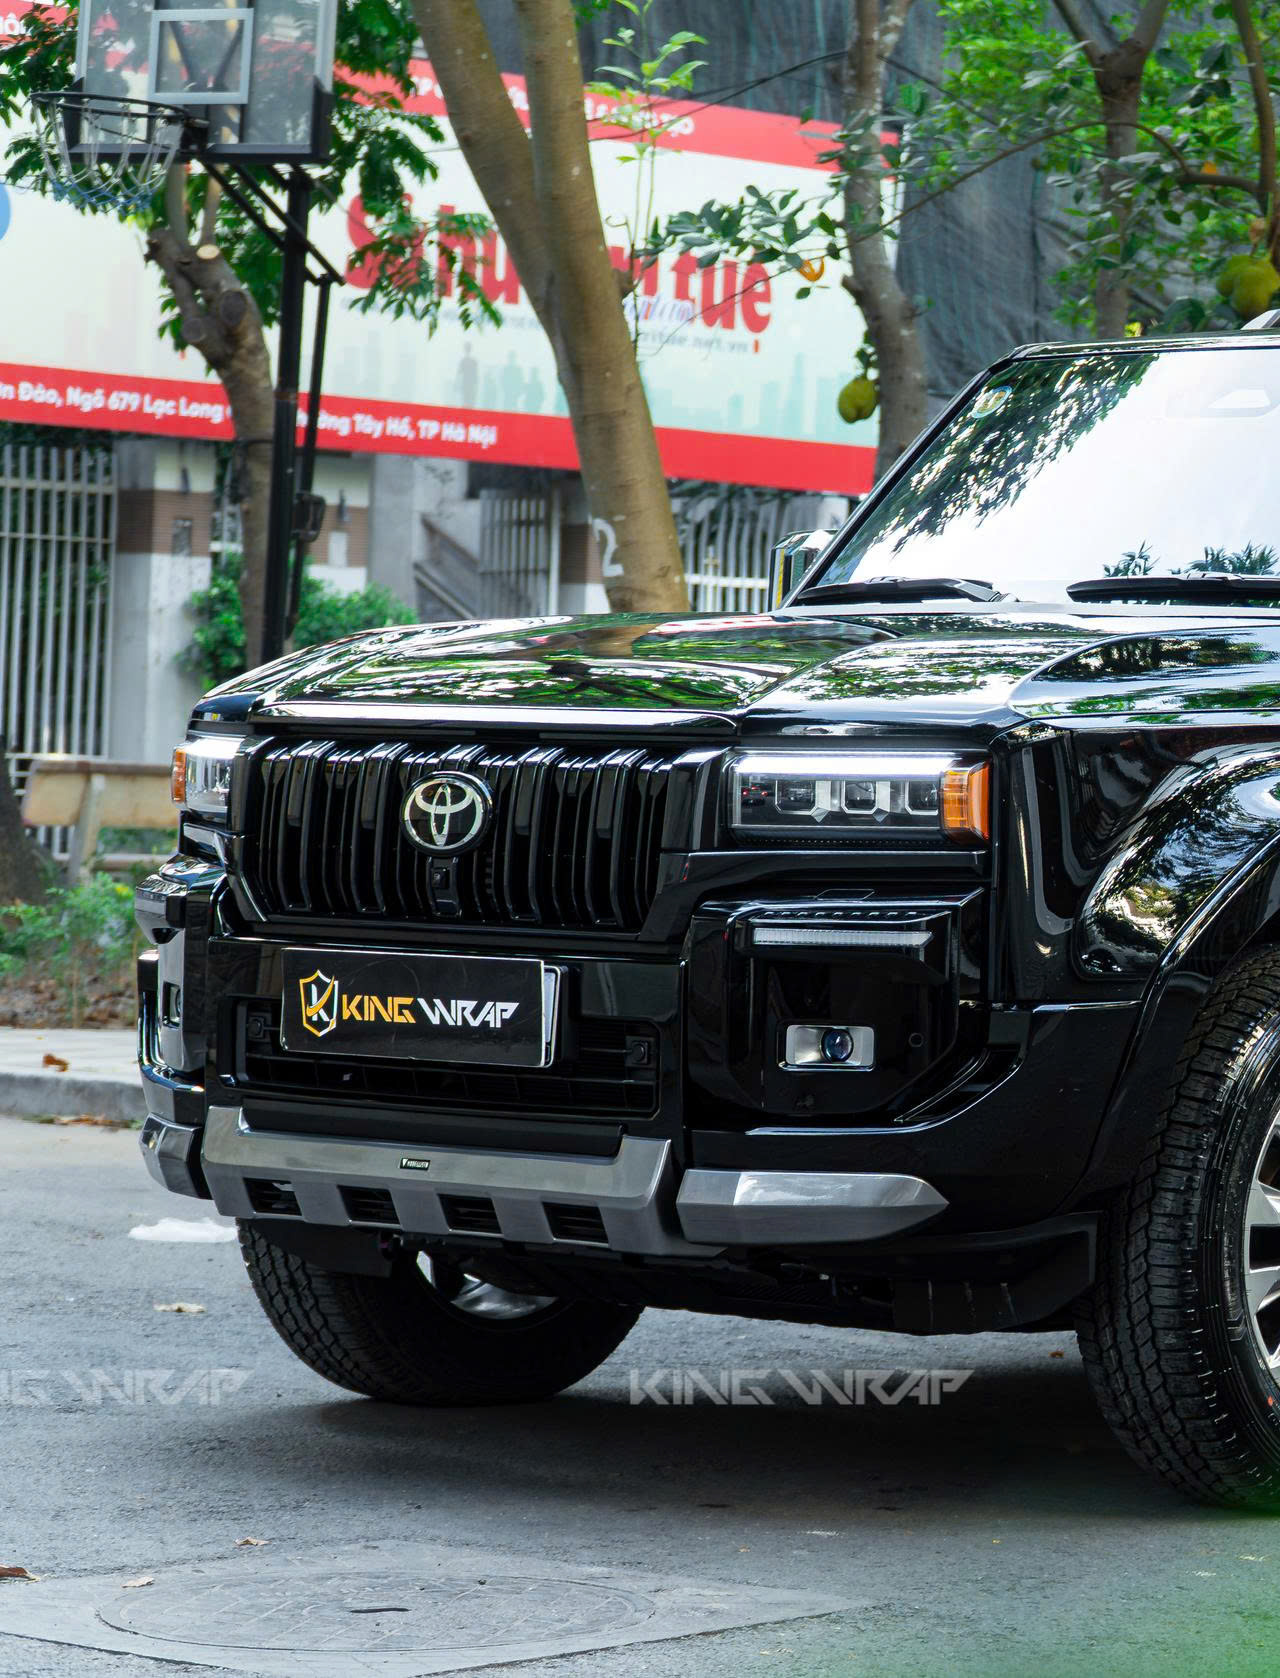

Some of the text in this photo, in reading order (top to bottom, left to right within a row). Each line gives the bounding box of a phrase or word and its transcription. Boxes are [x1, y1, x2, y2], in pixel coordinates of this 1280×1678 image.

[108, 390, 141, 412] 679
[178, 396, 224, 424] Long
[417, 418, 441, 440] TP
[341, 993, 417, 1024] KING
[417, 997, 520, 1028] WRAP
